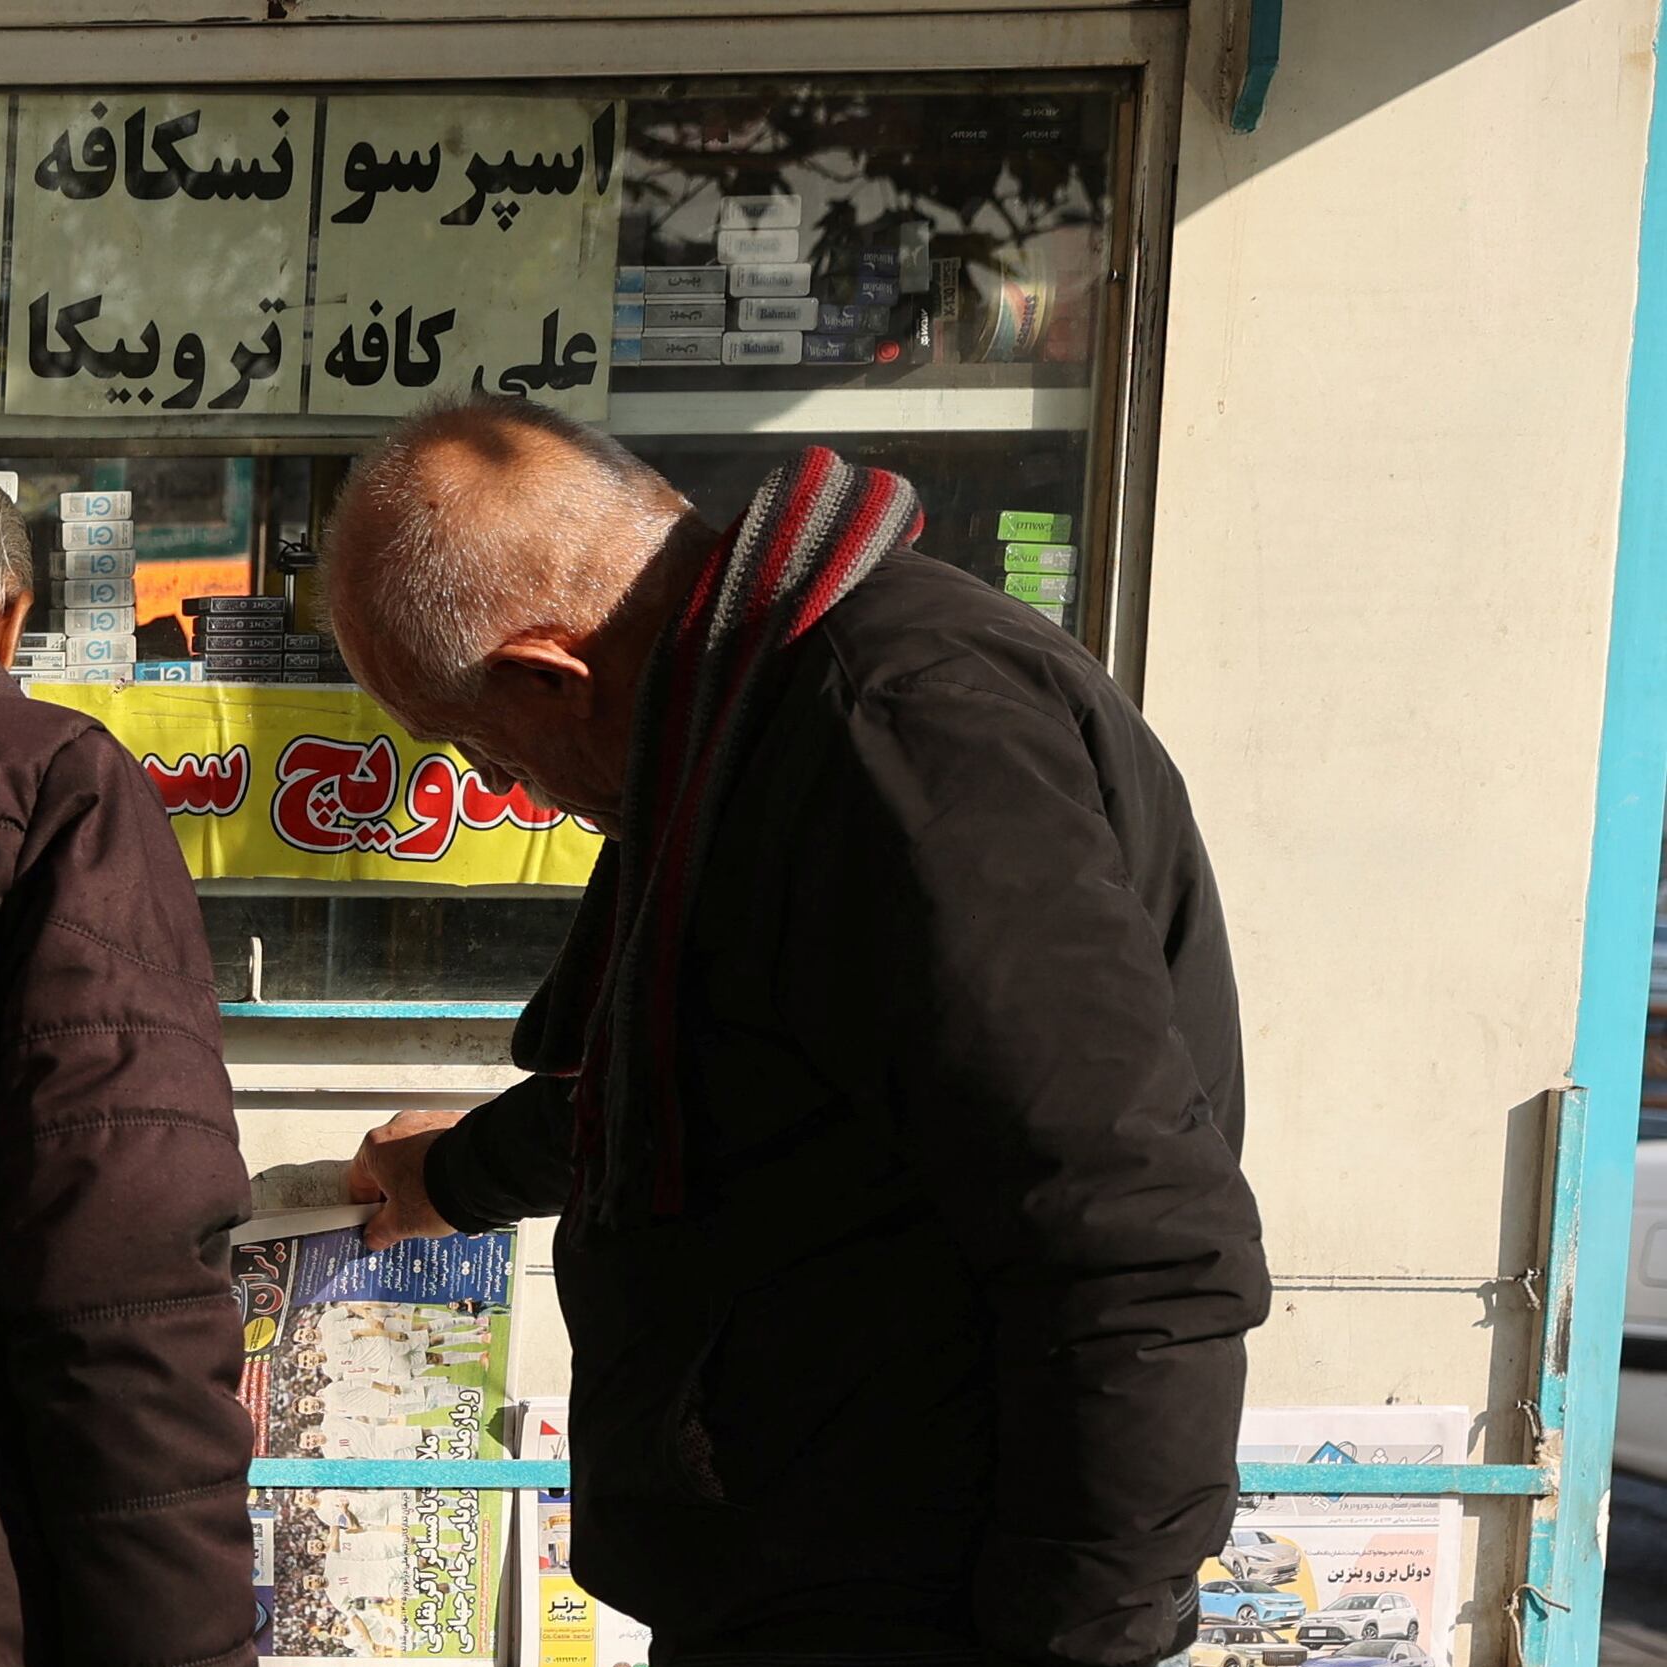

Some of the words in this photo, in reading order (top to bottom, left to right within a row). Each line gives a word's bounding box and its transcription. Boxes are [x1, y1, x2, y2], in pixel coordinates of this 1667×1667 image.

[34, 100, 295, 201] نسکافه
[331, 101, 616, 232] اسپرسو
[760, 309, 796, 319] Bahman
[324, 300, 456, 388] کافه
[743, 343, 780, 353] Bahman
[809, 345, 840, 357] Winston
[86, 496, 111, 515] G1
[88, 526, 113, 545] G1
[91, 555, 116, 574] G1
[91, 584, 115, 603] G1
[91, 612, 114, 631] G1
[33, 655, 63, 663] Montana
[86, 640, 111, 660] G1
[459, 1389, 481, 1402] و
[415, 1499, 444, 1513] با
[448, 1488, 478, 1551] روپایی
[415, 1514, 446, 1570] مسافر
[447, 1553, 476, 1591] جام
[1328, 1566, 1363, 1583] بنزین
[1367, 1572, 1371, 1582] و
[1374, 1569, 1398, 1582] برق
[1400, 1563, 1431, 1581] دوئل
[413, 1568, 445, 1654] آفریقایی
[548, 1596, 586, 1614] برتر
[446, 1592, 475, 1654] جهانی
